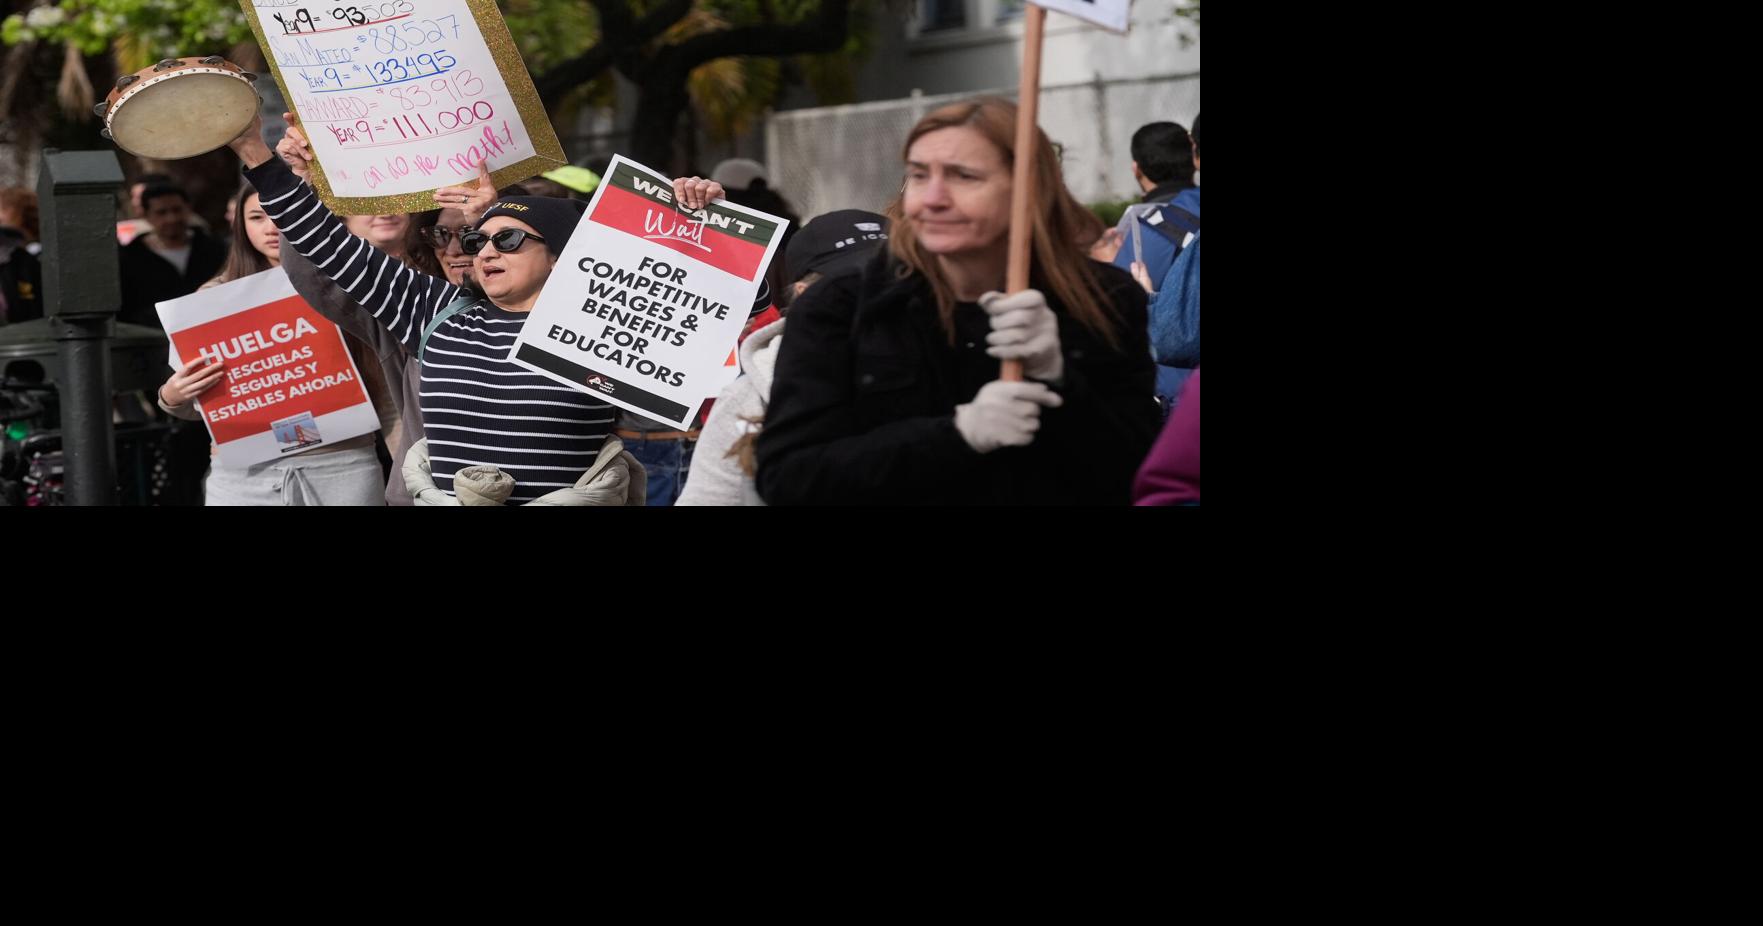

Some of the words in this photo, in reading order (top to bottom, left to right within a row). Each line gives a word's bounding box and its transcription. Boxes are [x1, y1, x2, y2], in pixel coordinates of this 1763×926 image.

[633, 176, 672, 203] WE
[678, 201, 755, 234] CAN'T
[644, 207, 707, 246] Wait
[578, 257, 730, 320] COMPETITIVE
[638, 256, 688, 286] FOR
[581, 298, 688, 347] BENEFITS
[588, 278, 676, 321] WAGES
[680, 314, 699, 332] &
[198, 317, 318, 366] HUELGA
[547, 324, 686, 387] EDUCATORS
[600, 325, 649, 354] FOR
[227, 345, 313, 384] ¡ESCUELAS
[229, 365, 306, 397] SEGURAS
[304, 362, 319, 374] Y
[208, 390, 286, 423] ESTABLES
[289, 368, 354, 399] AHORA!
